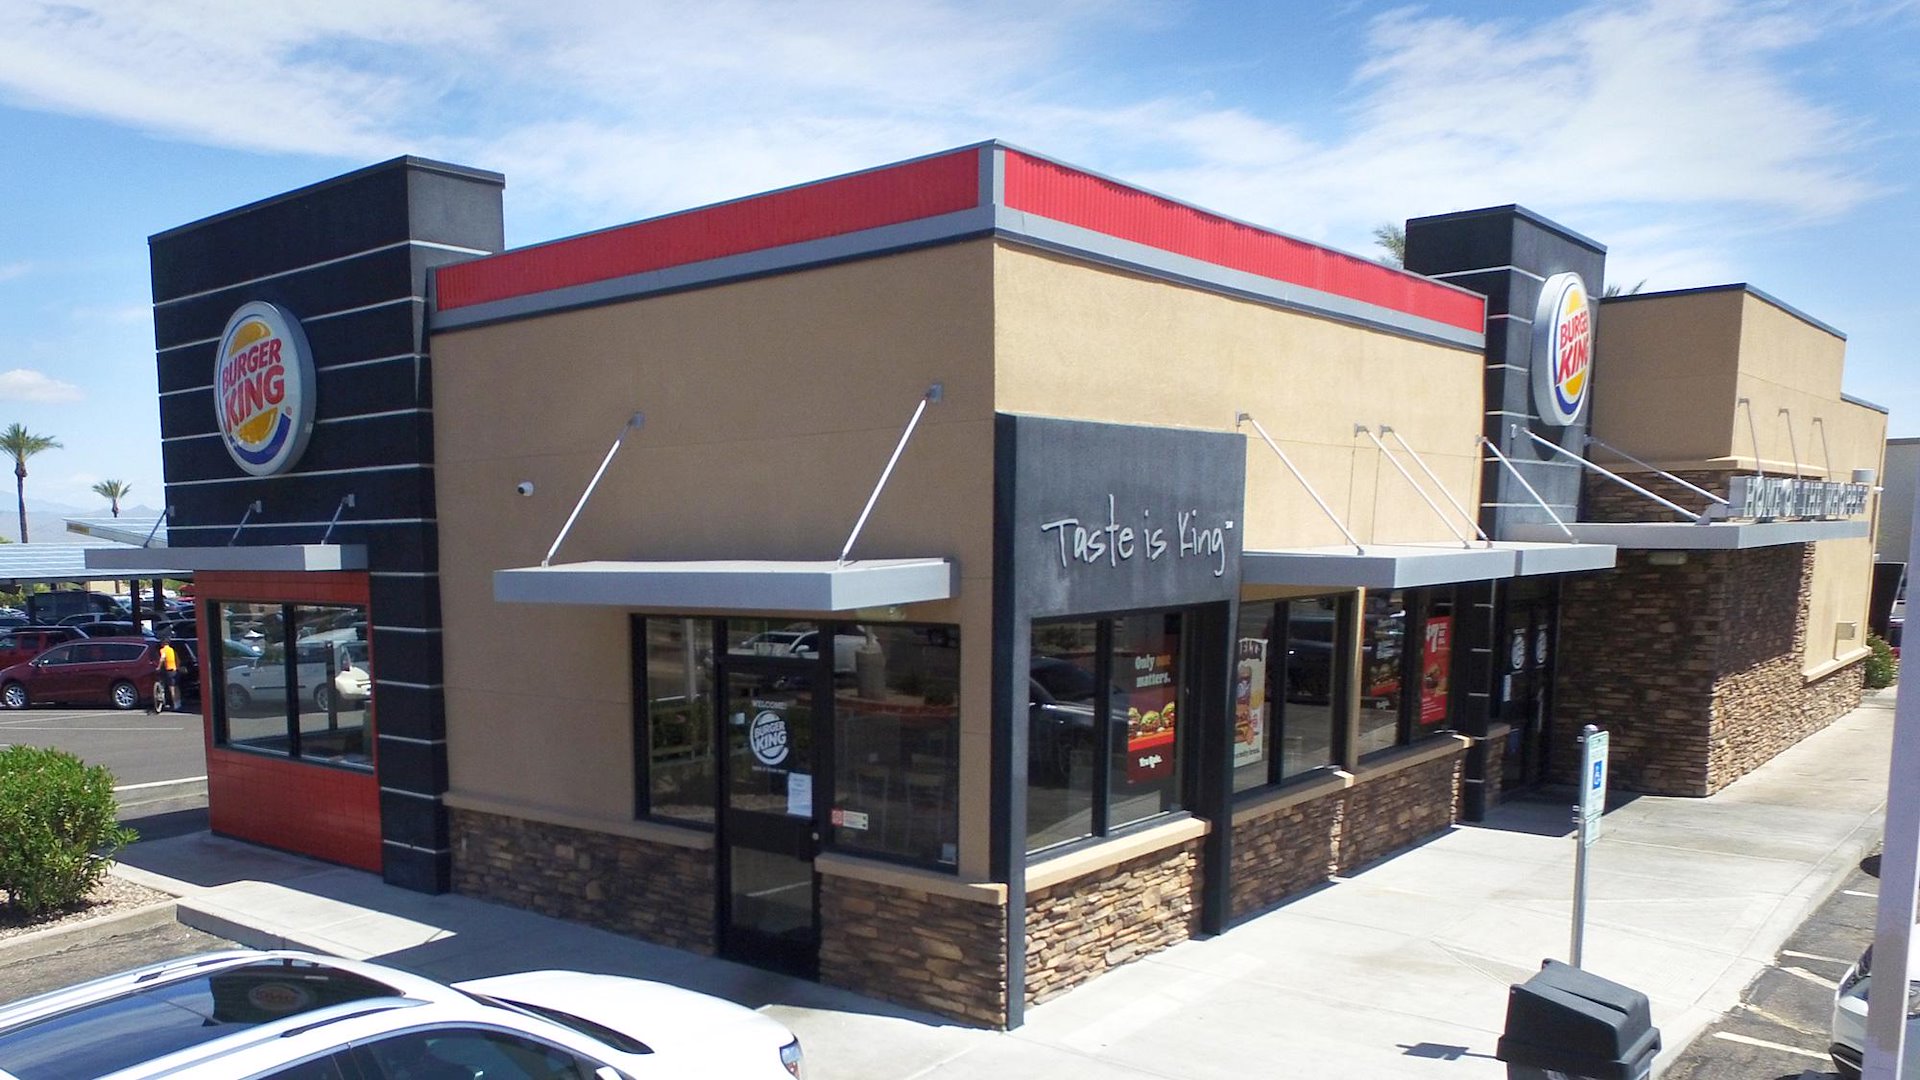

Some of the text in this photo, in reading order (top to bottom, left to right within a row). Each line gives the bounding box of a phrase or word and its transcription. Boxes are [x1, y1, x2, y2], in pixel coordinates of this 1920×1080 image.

[1560, 310, 1589, 349] BURG
[222, 338, 282, 395] BURGER
[223, 365, 285, 433] KING
[1743, 476, 1782, 518] HOME
[1041, 494, 1225, 576] Taste is King
[1135, 654, 1155, 671] Only
[1136, 672, 1171, 688] matters.
[755, 720, 785, 738] BURGER
[755, 731, 787, 751] KING
